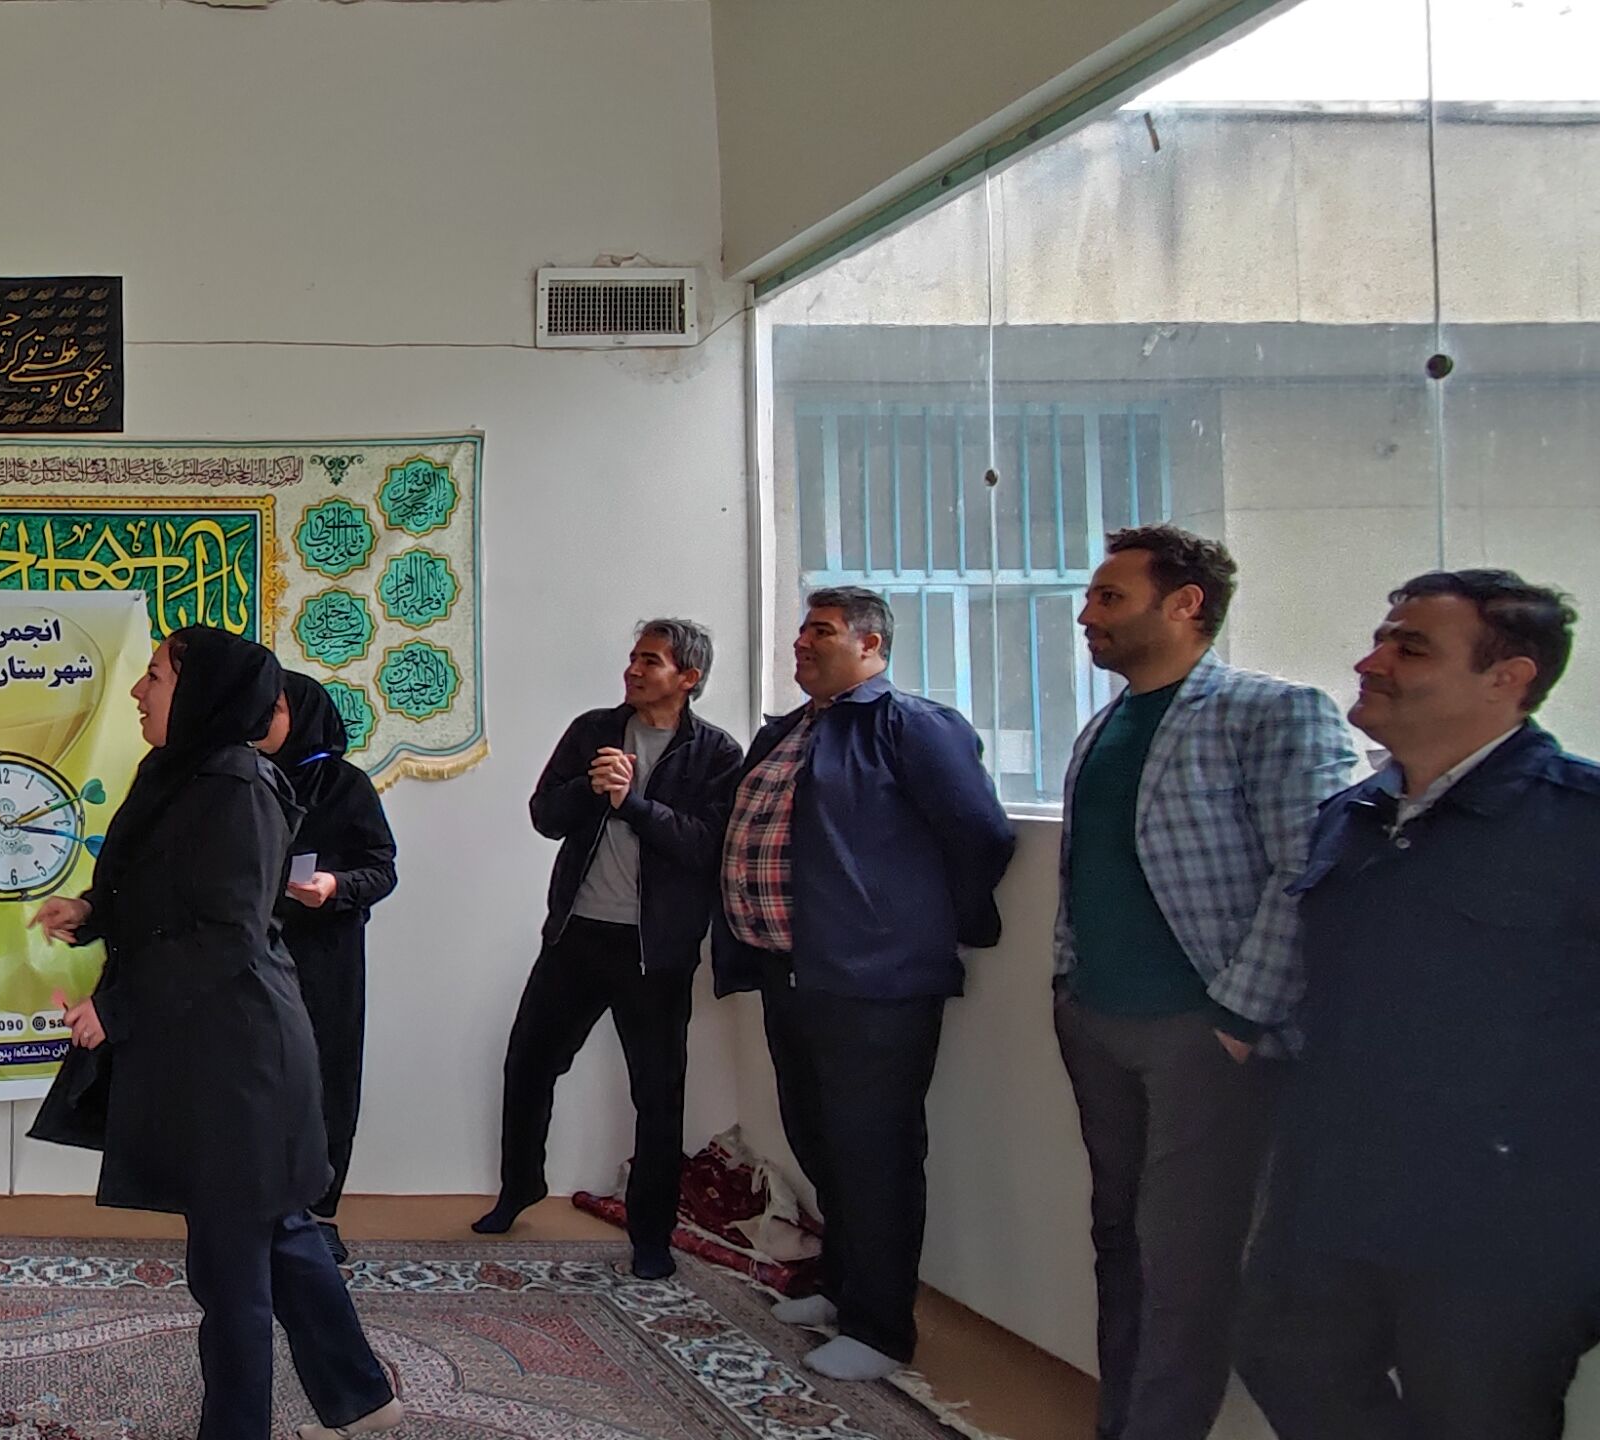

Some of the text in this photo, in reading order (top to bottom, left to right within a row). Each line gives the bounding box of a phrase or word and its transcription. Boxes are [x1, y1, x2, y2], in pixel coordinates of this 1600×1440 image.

[25, 773, 35, 789] 1
[53, 820, 71, 828] 3
[52, 844, 66, 855] 4
[34, 860, 47, 877] 5
[11, 869, 18, 885] 6
[48, 1018, 65, 1029] sa
